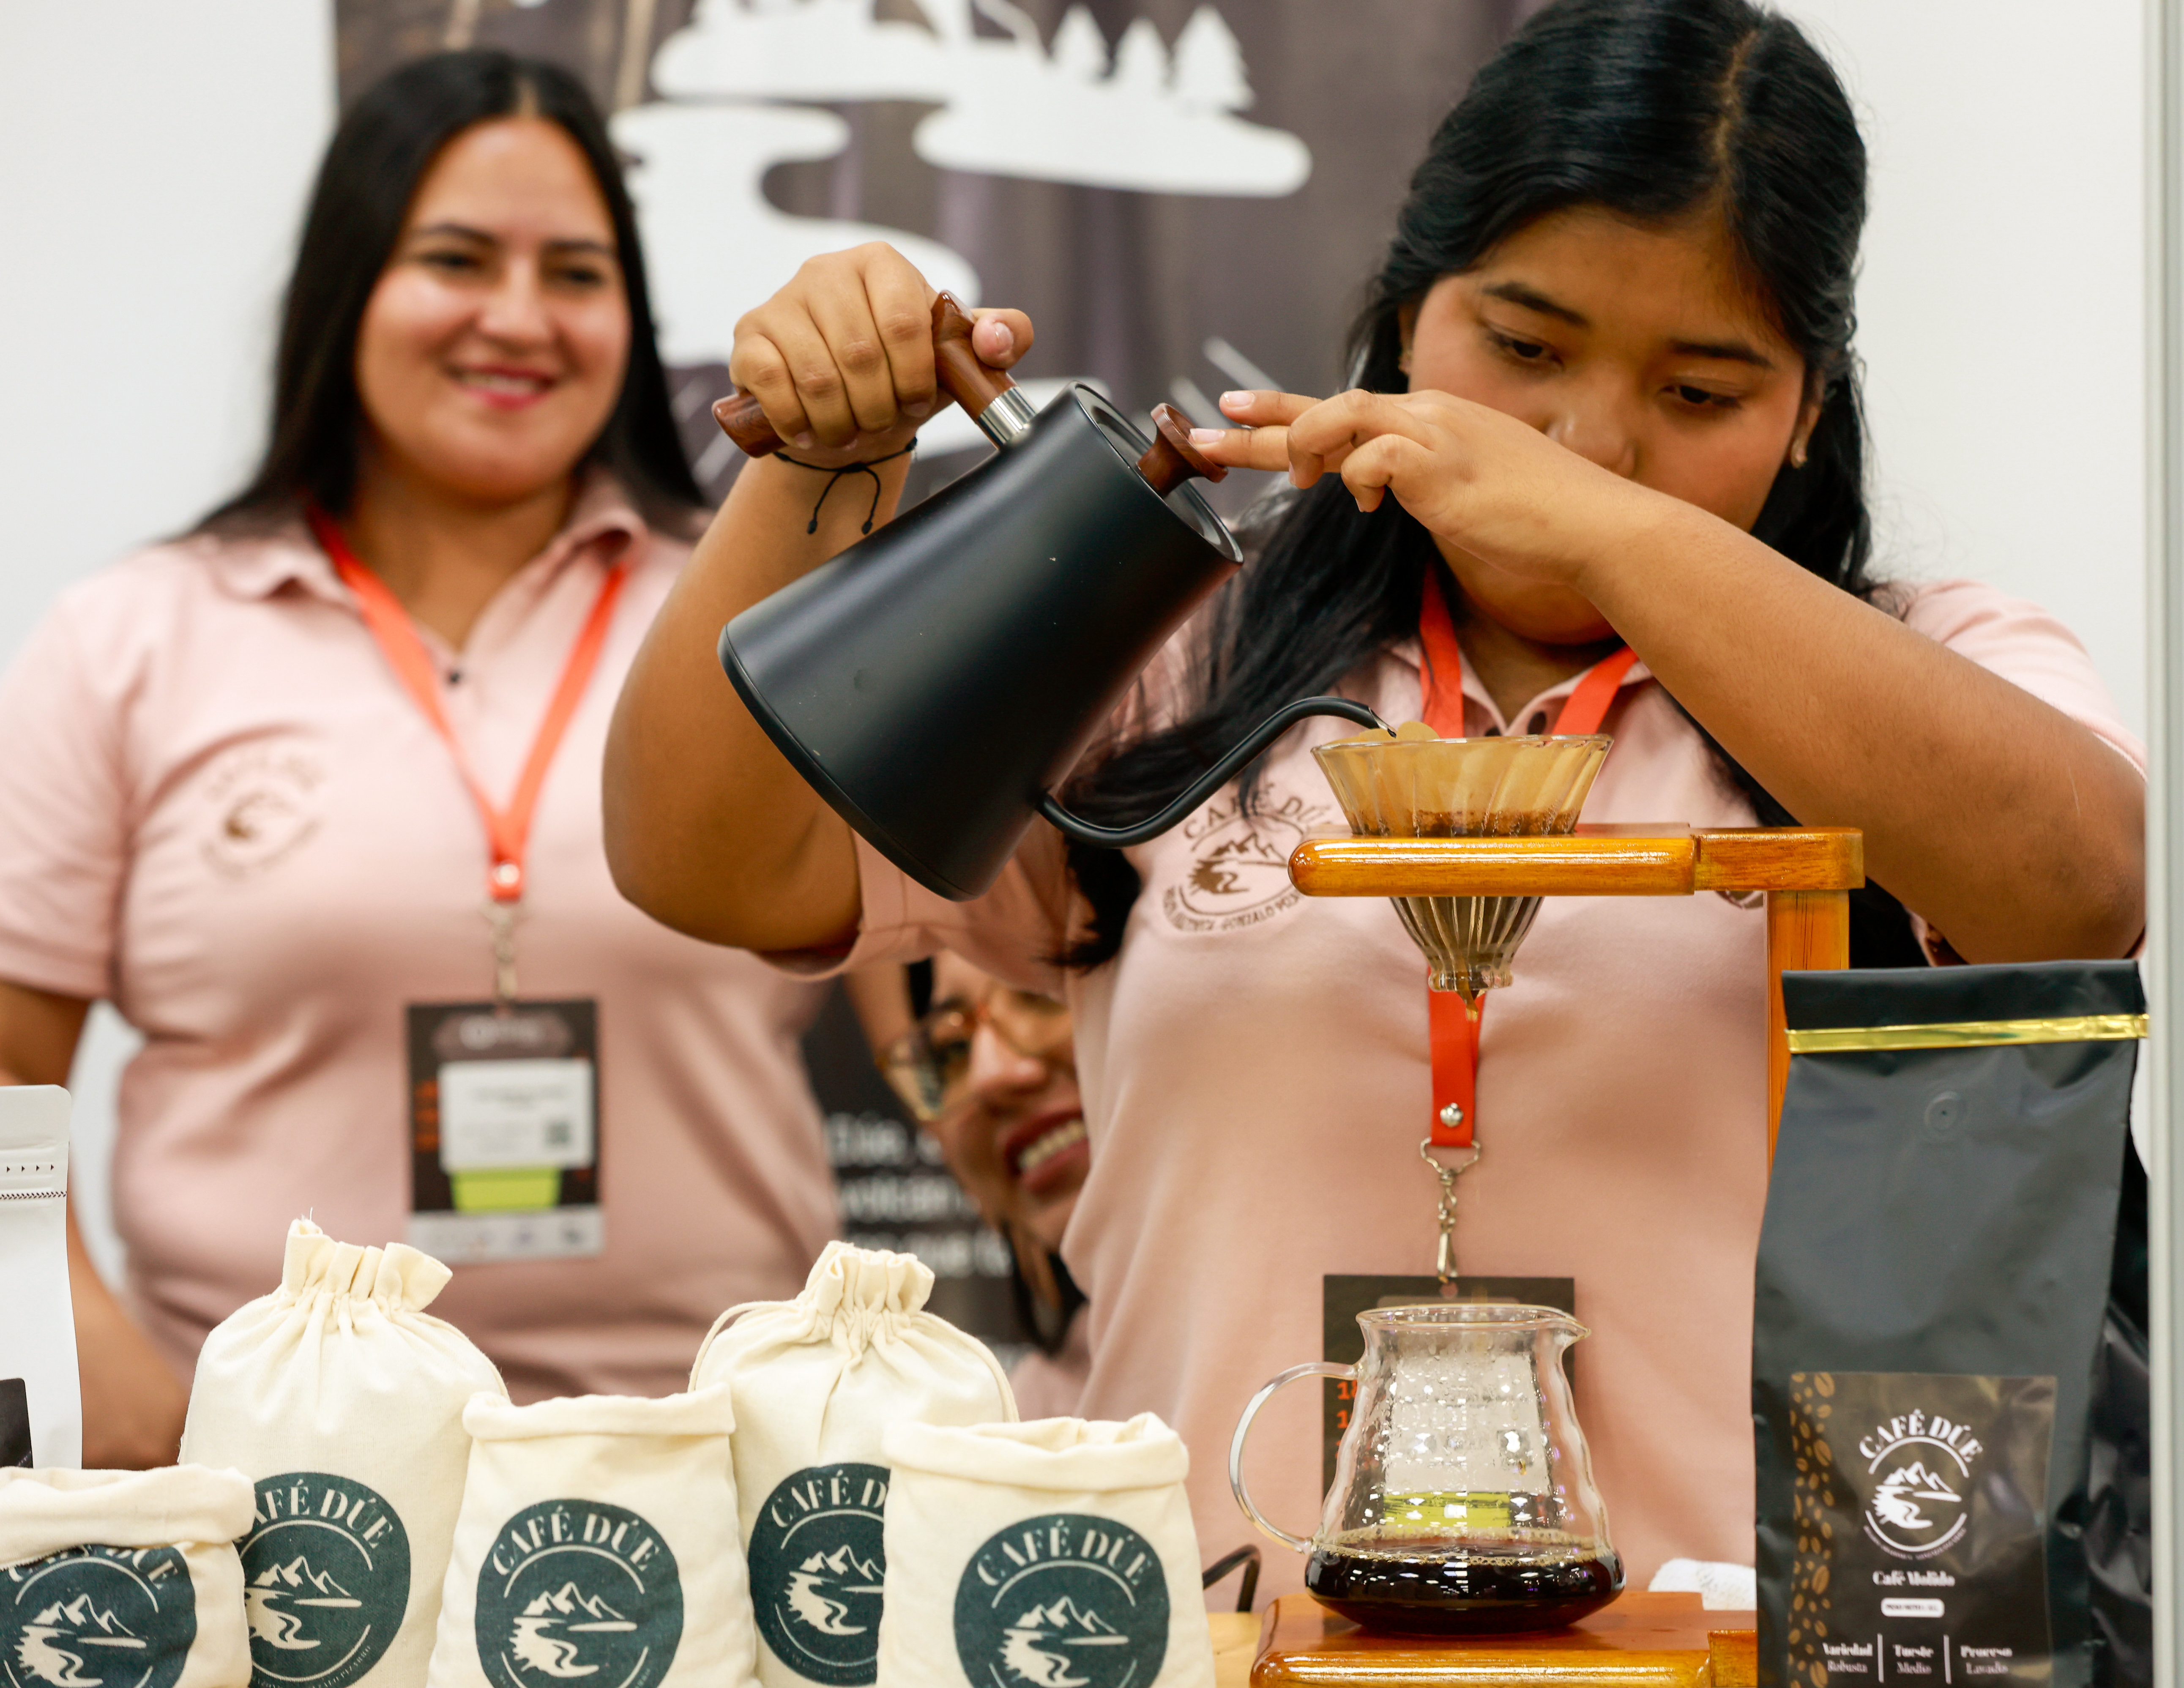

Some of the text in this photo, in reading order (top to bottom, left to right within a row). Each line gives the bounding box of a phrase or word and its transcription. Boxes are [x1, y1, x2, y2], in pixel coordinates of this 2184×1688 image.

[1859, 1408, 1984, 1463] CAFÉ DÚE
[771, 1469, 851, 1528] CAFÉ
[243, 1479, 394, 1549] AFÉ DÚE
[493, 1504, 661, 1576] CAFÉ DÚE
[977, 1518, 1153, 1587] CAFÉ DÚE
[1872, 1569, 1956, 1587] Café Molido
[1822, 1642, 1873, 1657] Variedad
[1892, 1644, 1934, 1658] Tueste
[1960, 1644, 2013, 1658] Proceso
[1827, 1659, 1868, 1674] Robusta
[1896, 1661, 1932, 1675] Medio
[1965, 1661, 2009, 1675] Lavado
